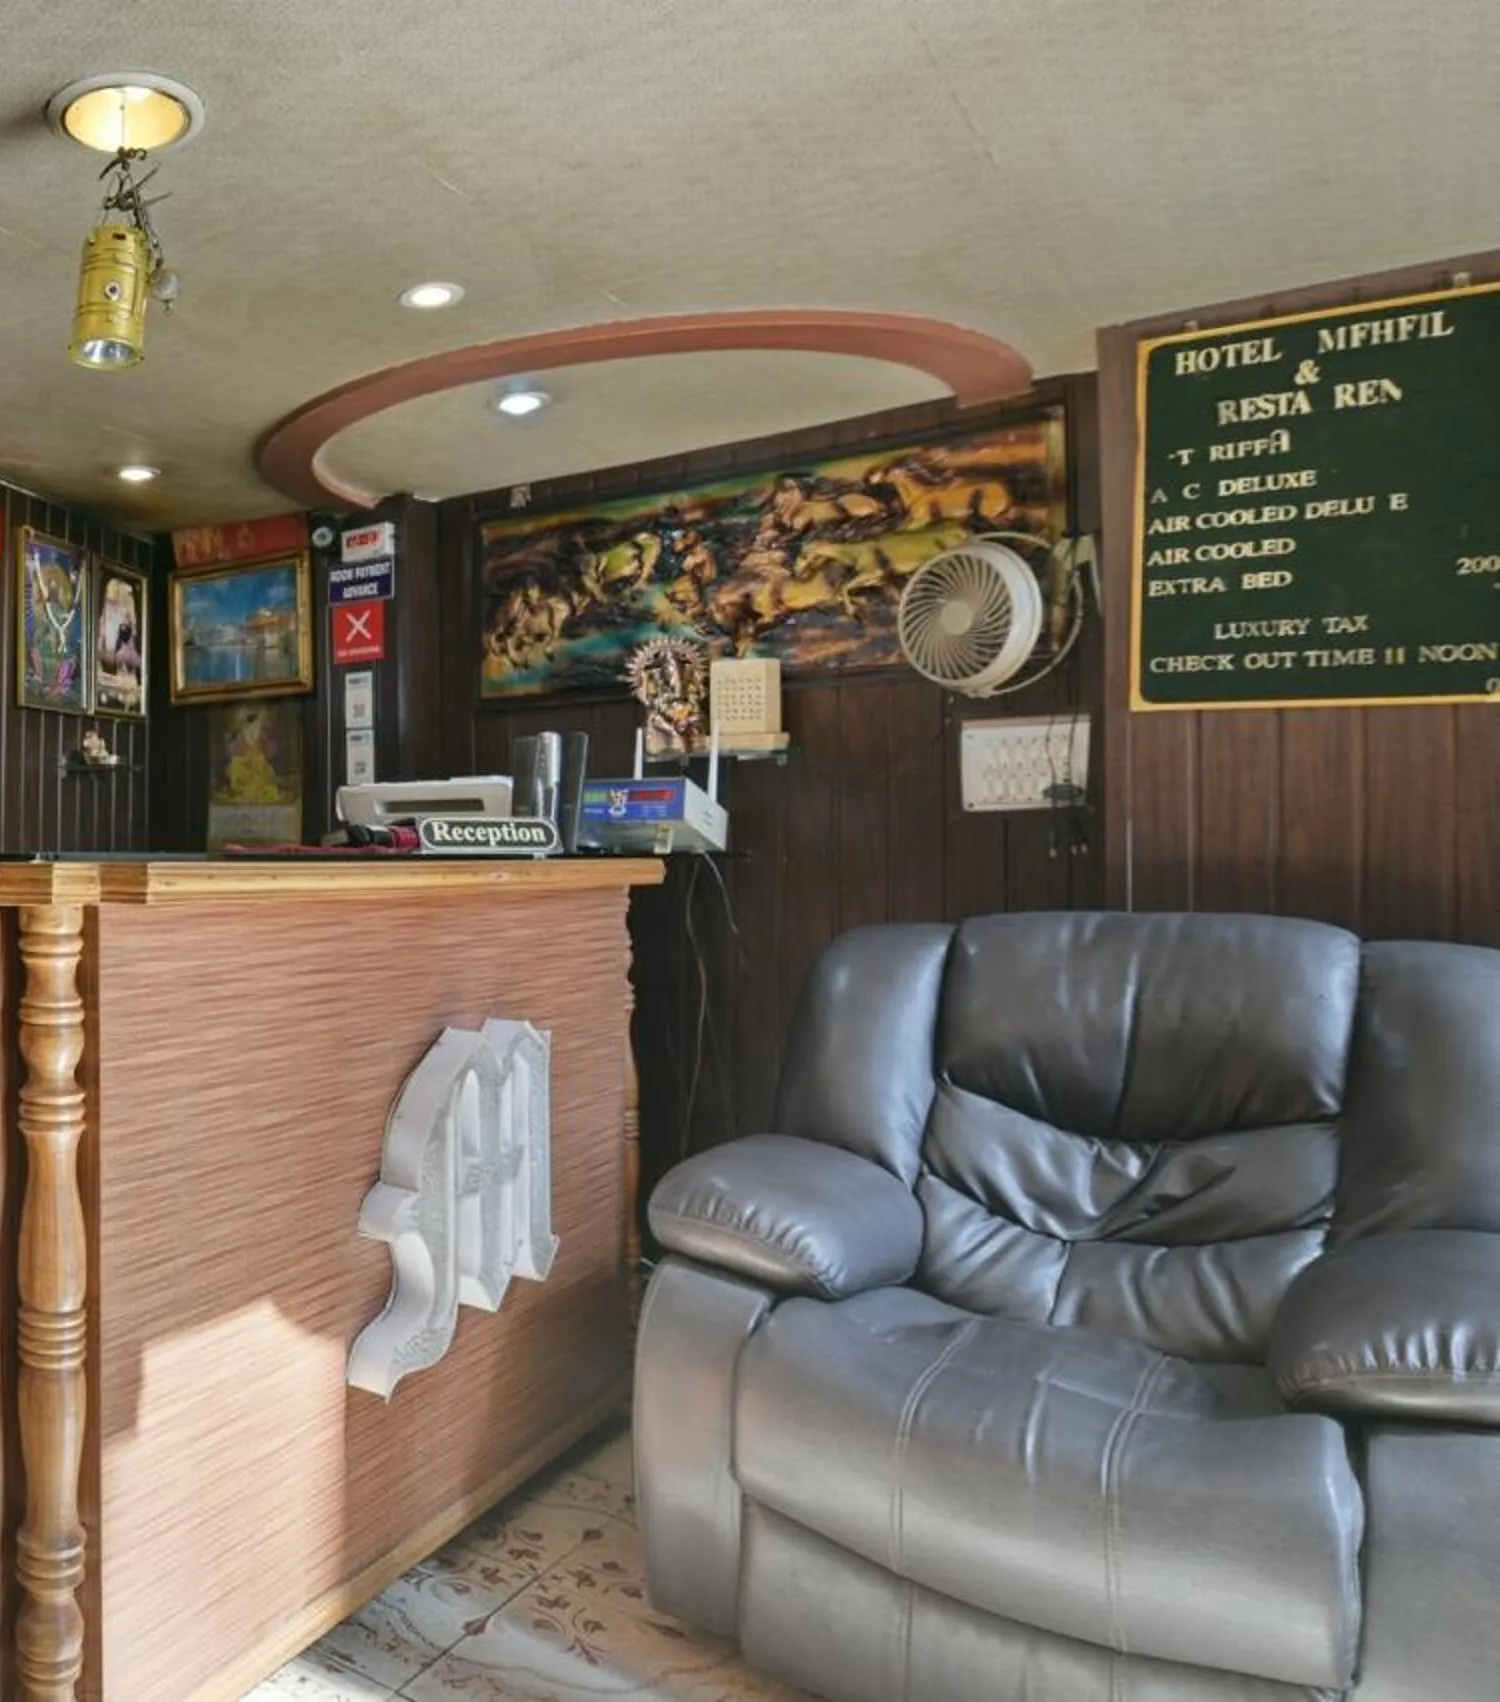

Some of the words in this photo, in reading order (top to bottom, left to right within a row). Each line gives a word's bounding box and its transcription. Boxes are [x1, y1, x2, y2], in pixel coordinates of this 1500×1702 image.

[1174, 337, 1283, 376] HOTEL
[1294, 359, 1321, 385] &
[1182, 483, 1201, 499] C
[1218, 469, 1317, 497] DELUXE
[1147, 515, 1191, 535] AIR
[1195, 505, 1298, 530] COOLED
[1147, 547, 1190, 567] AIR
[1194, 538, 1297, 562] COOLED
[1148, 577, 1226, 598] EXTRA
[1241, 570, 1293, 590] BED
[1214, 618, 1311, 640] LUXURY
[1323, 615, 1369, 634] TAX
[1150, 654, 1235, 673] CHECK
[1244, 651, 1297, 670] OUT
[1303, 648, 1375, 669] TIME
[1418, 642, 1498, 663] NOON
[430, 821, 547, 847] Reception
